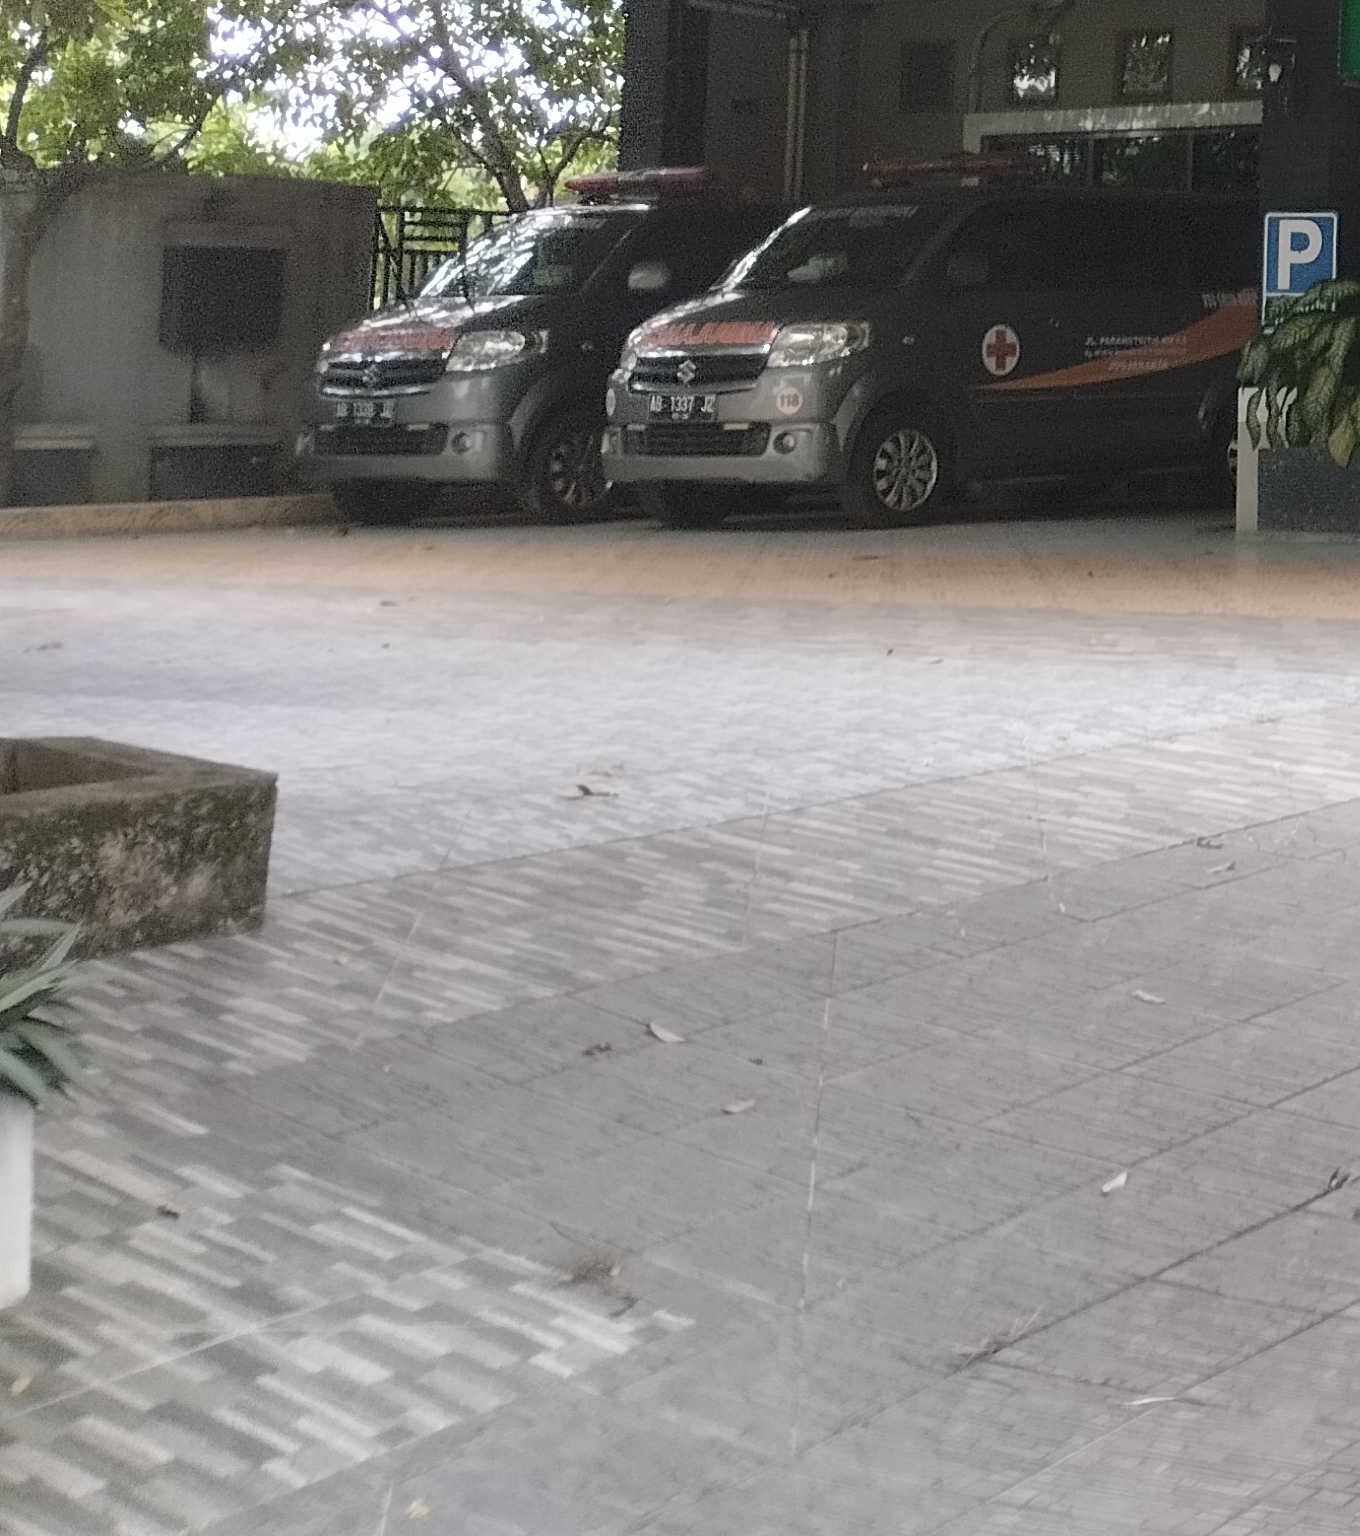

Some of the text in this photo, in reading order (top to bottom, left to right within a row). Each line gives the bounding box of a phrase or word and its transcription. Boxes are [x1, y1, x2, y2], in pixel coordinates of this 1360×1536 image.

[1278, 219, 1322, 290] P
[650, 396, 663, 413] AB
[671, 396, 694, 413] 1337
